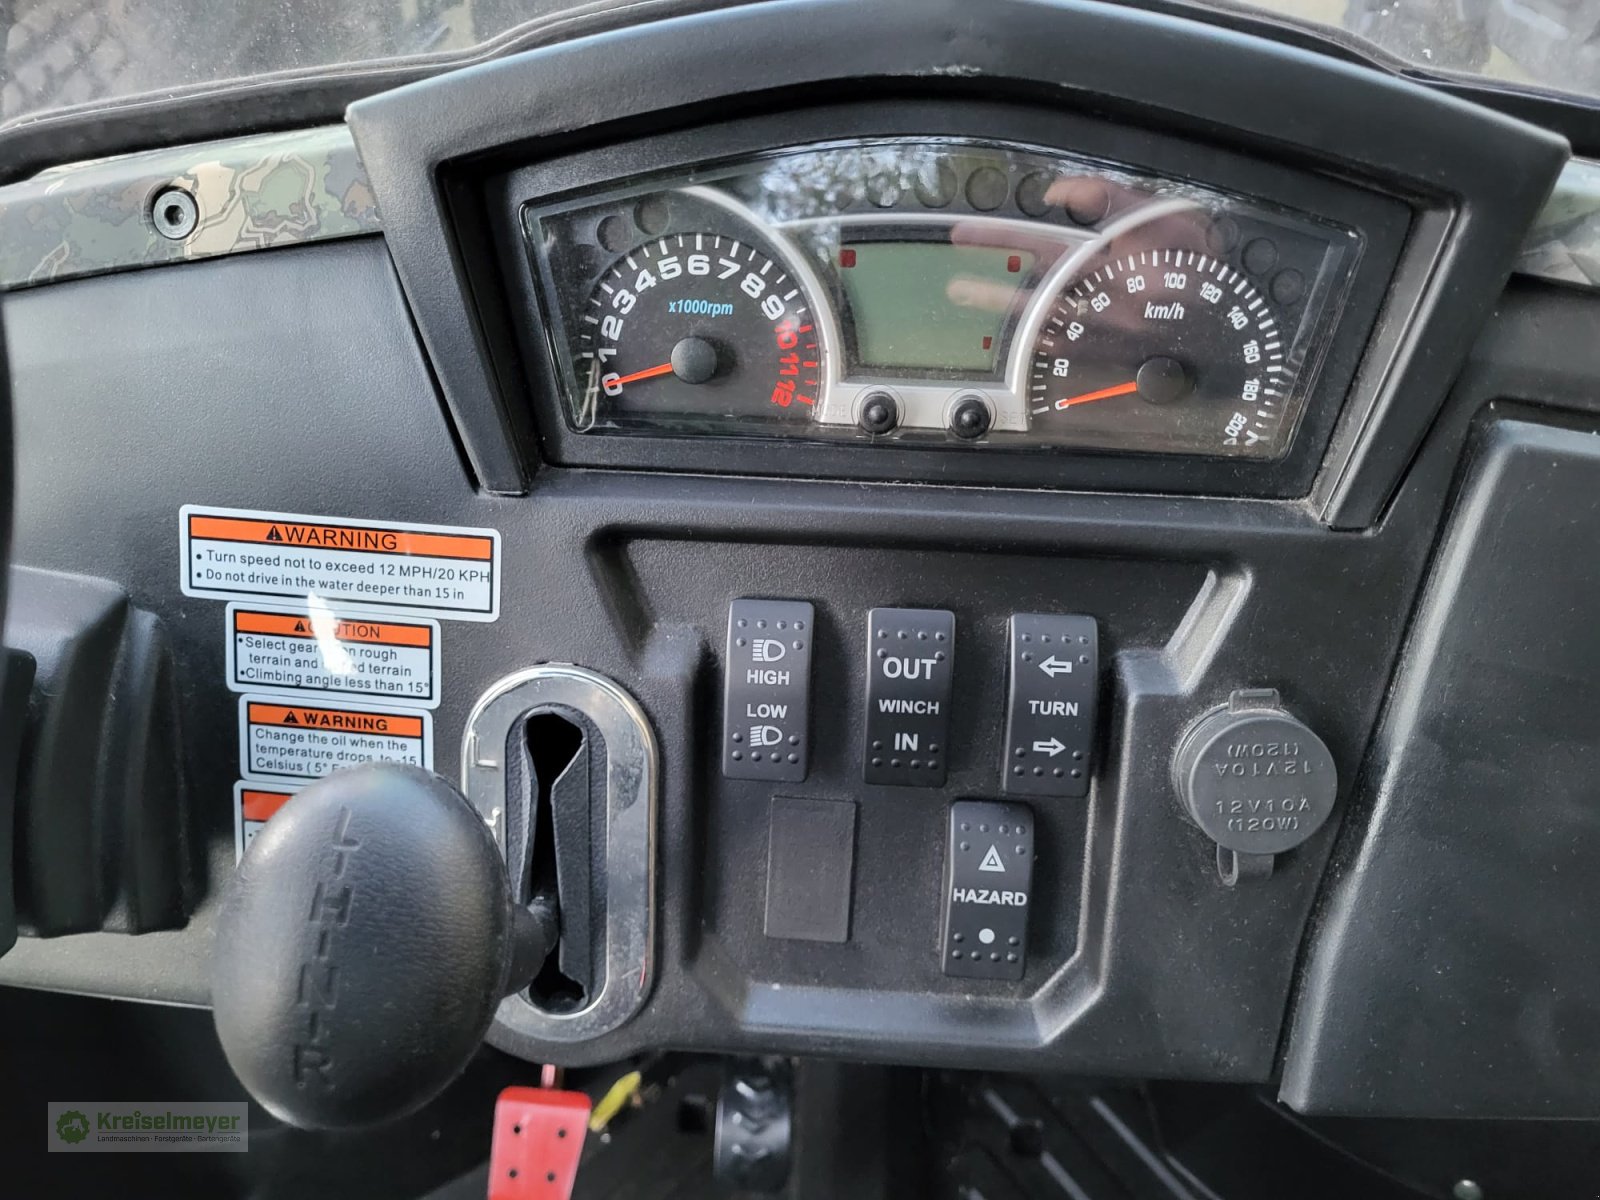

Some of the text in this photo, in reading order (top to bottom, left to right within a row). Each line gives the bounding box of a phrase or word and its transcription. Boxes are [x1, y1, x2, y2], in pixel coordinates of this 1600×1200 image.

[656, 256, 683, 280] 5
[687, 254, 710, 276] 6
[717, 257, 741, 280] 7
[634, 269, 657, 293] 4
[740, 272, 766, 299] 8
[1126, 275, 1146, 294] 80
[1163, 272, 1187, 289] 100
[612, 288, 637, 315] 3
[1090, 291, 1111, 313] 60
[1199, 281, 1223, 305] 120
[668, 299, 734, 318] x1000rpm
[761, 294, 786, 321] 9
[1144, 301, 1185, 320] km/h
[1227, 305, 1249, 330] 140
[601, 315, 624, 341] 2
[774, 320, 798, 350] 10
[1065, 321, 1084, 342] 40
[598, 347, 617, 363] 1
[1242, 339, 1261, 364] 160
[779, 352, 799, 377] 11
[1052, 358, 1070, 377] 20
[601, 372, 623, 397] 0
[771, 380, 796, 407] 12
[1242, 379, 1260, 401] 180
[1224, 411, 1248, 437] 200
[285, 526, 397, 550] WARNING
[206, 549, 490, 583] Turn speed not to exceed 12 MPH/20 KPH
[206, 568, 464, 600] Do not drive in the water deeper than 15 in
[308, 621, 380, 639] UTION
[245, 636, 286, 651] Select
[360, 649, 397, 661] rough
[249, 653, 291, 667] terrain
[295, 657, 318, 669] and
[369, 662, 411, 677] terrain
[882, 657, 937, 680] OUT
[245, 667, 302, 685] Climbing
[306, 674, 341, 689] angle
[345, 675, 371, 689] less
[375, 678, 404, 692] than
[746, 669, 790, 686] HIGH
[746, 703, 788, 719] LOW
[878, 699, 940, 715] WINCH
[1028, 700, 1079, 717] TURN
[304, 712, 388, 731] WARNING
[255, 728, 408, 752] Change the oil when the
[894, 733, 919, 752] IN
[255, 744, 333, 760] temperature
[256, 757, 303, 771] Celsius
[1227, 816, 1299, 832] (120W)
[953, 887, 1028, 907] HAZARD
